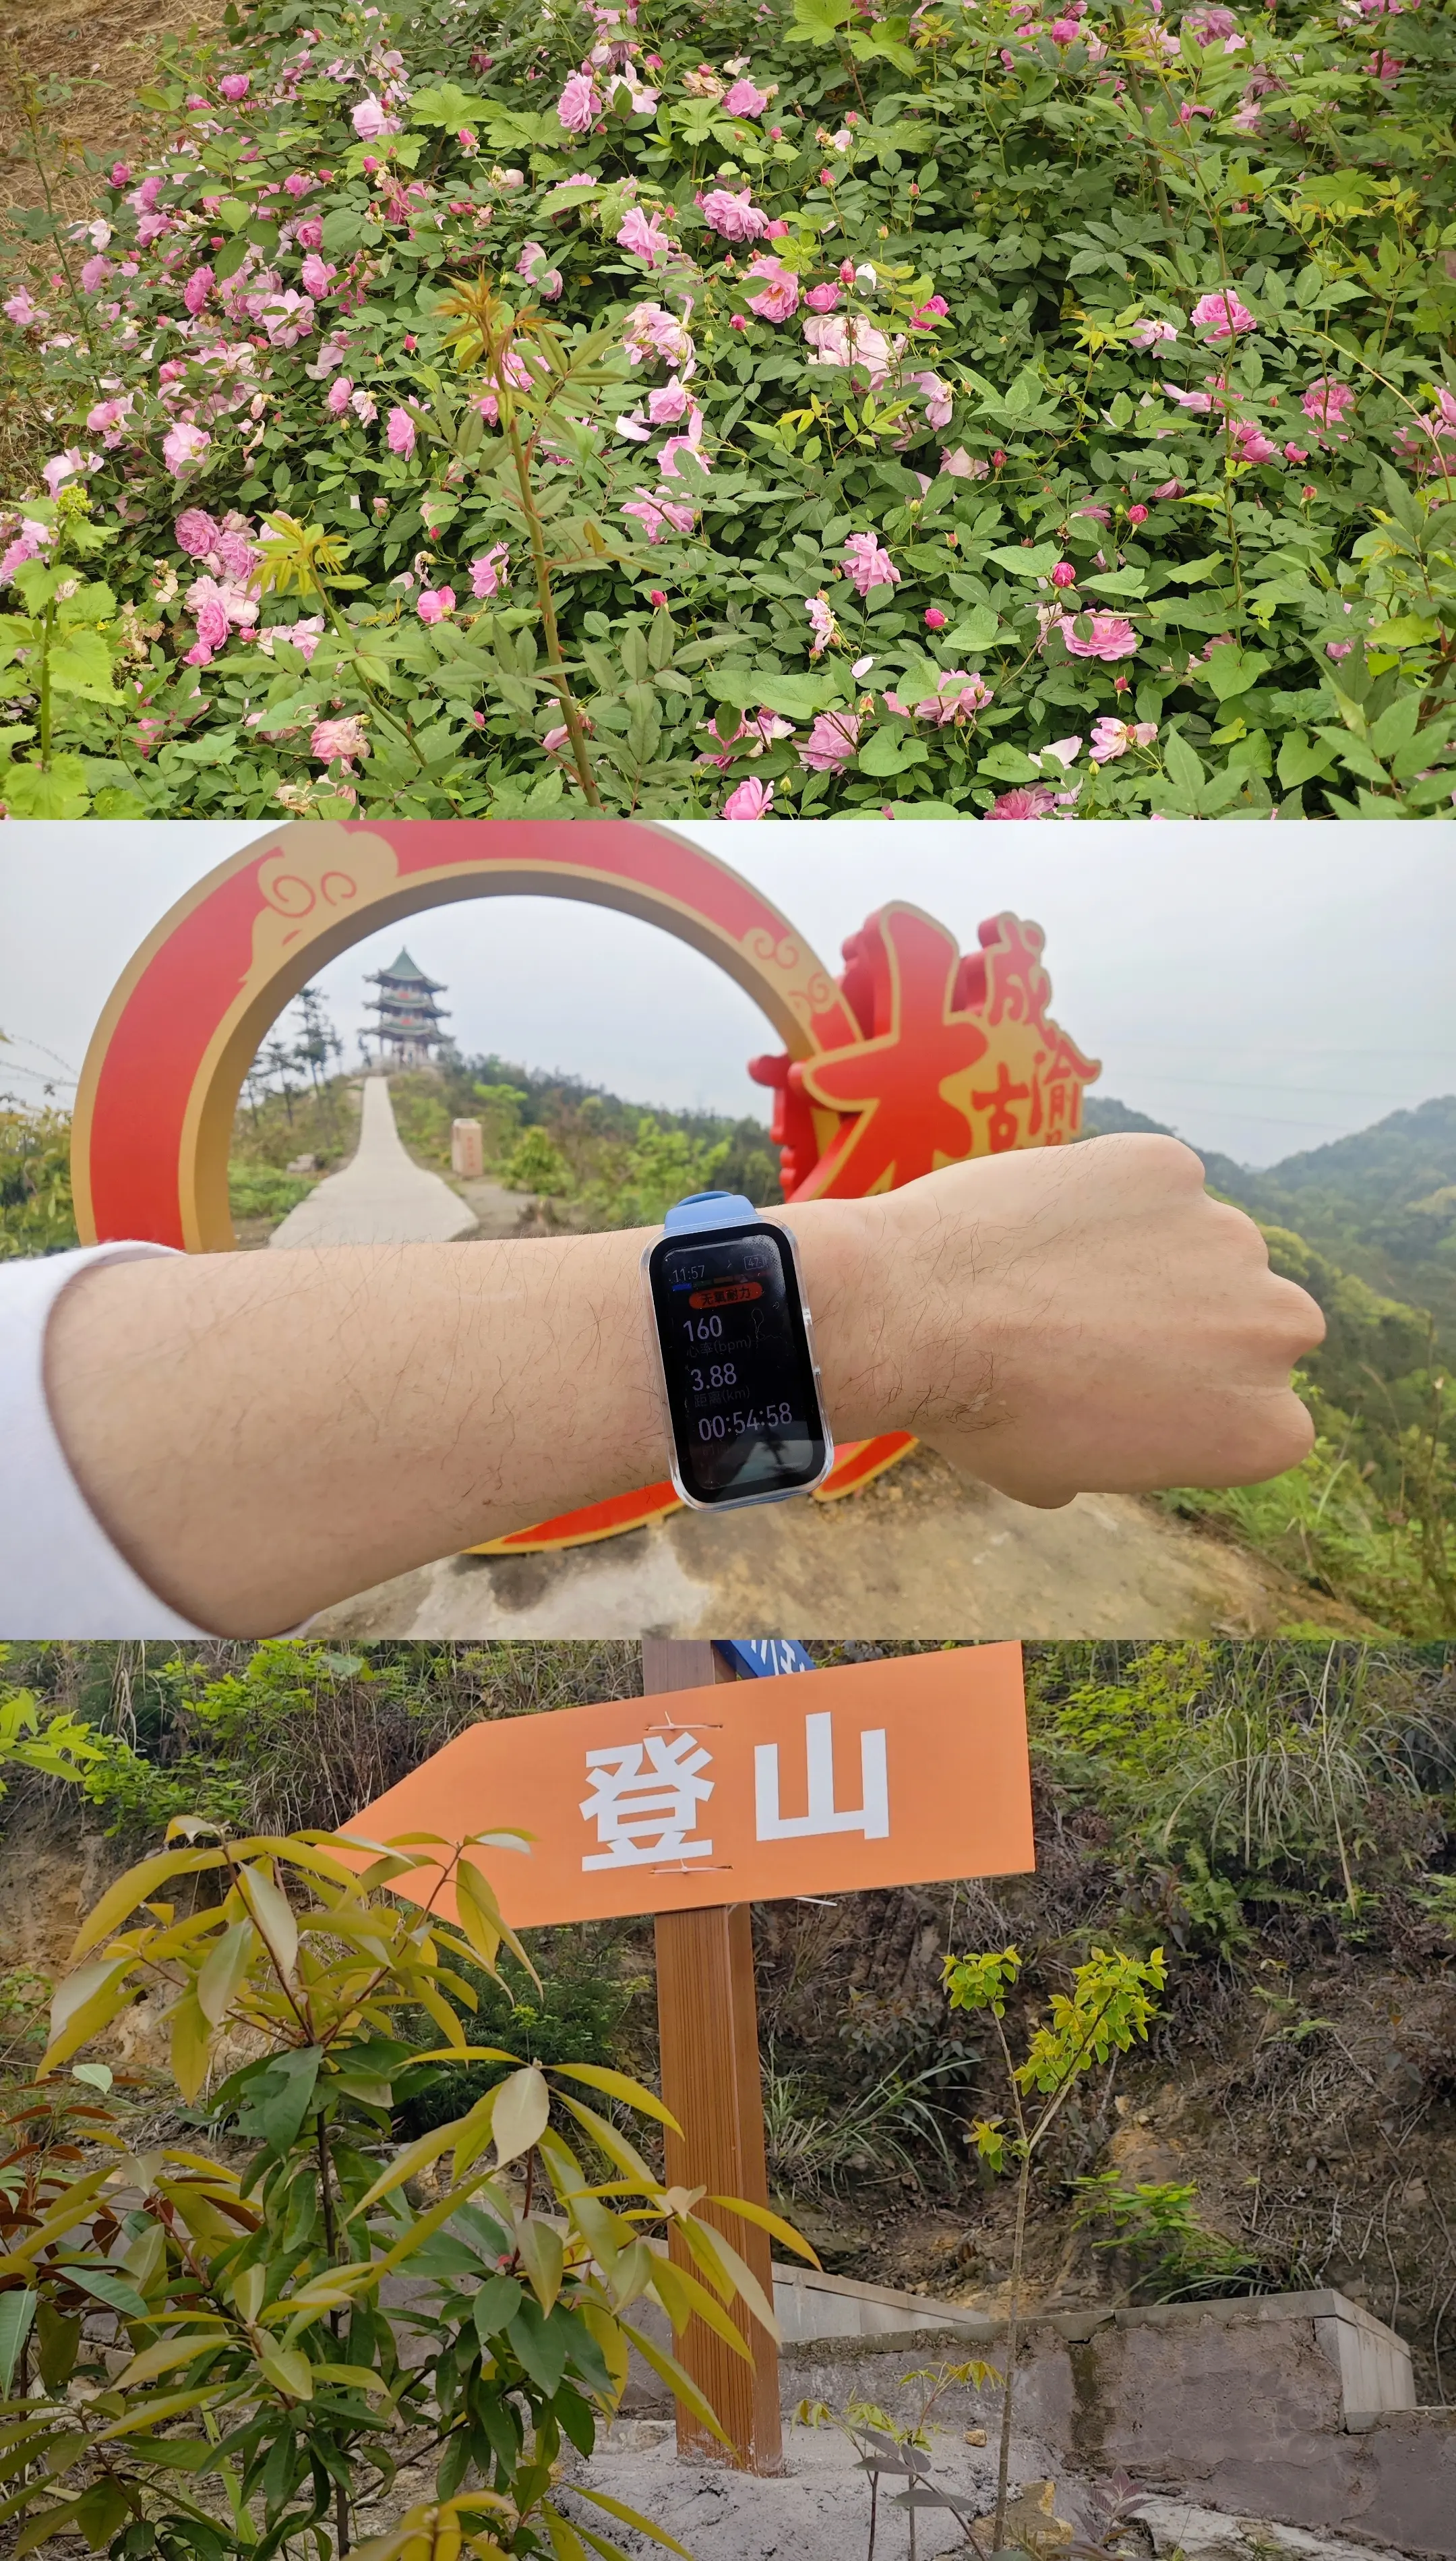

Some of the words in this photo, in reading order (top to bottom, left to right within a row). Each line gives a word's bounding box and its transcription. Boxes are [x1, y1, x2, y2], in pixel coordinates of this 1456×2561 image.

[673, 1265, 704, 1283] 11:57
[683, 1315, 723, 1342] 160
[690, 1363, 737, 1391] 3.88
[698, 1403, 792, 1440] 00:54:58
[578, 1711, 890, 1872] 登山
